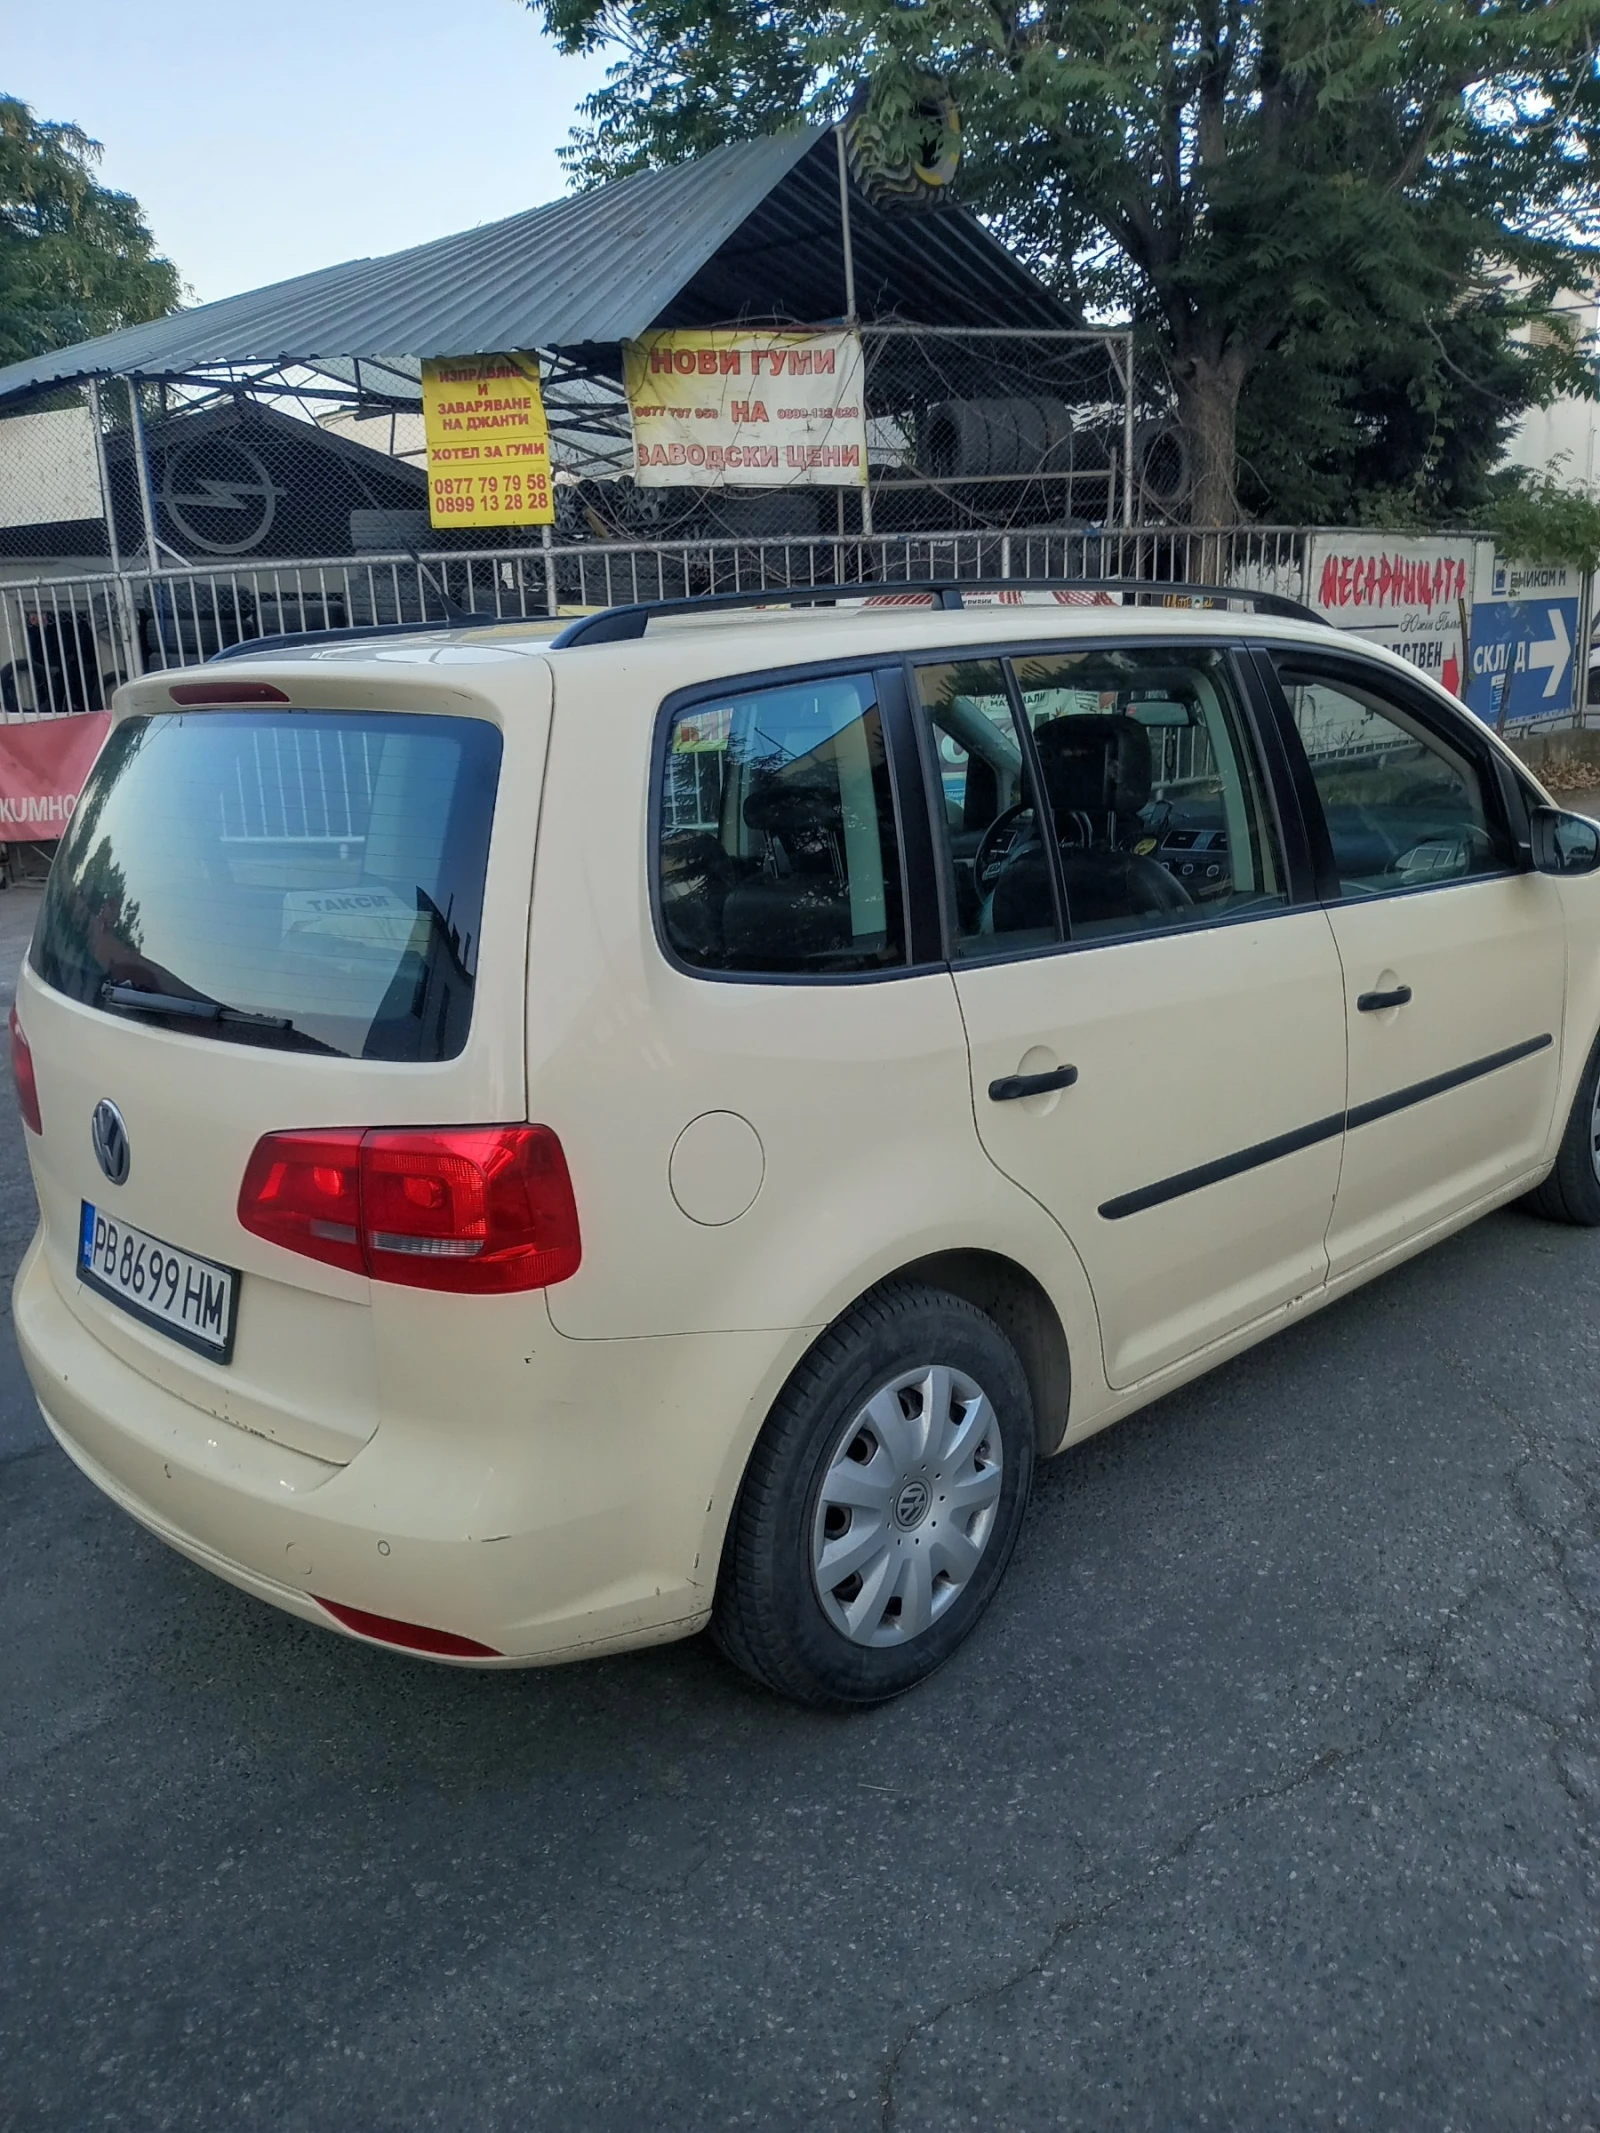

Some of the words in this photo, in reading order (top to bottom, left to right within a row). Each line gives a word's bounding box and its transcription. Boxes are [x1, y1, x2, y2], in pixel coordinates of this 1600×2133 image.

[650, 347, 740, 375] НОВИ
[751, 349, 835, 376] ГУМИ
[478, 383, 488, 396] И
[438, 397, 531, 414] ЗАВАРЯВАНЕ
[731, 400, 769, 422] НА
[443, 418, 463, 430] НА
[467, 414, 529, 431] ДЖАНТИ
[432, 447, 480, 460] ХОТЕЛ
[484, 445, 503, 458] ЗА
[506, 443, 545, 456] ГУМИ
[637, 443, 778, 471] ЗАВОДСКИ
[787, 445, 859, 471] ЦЕНИ
[434, 478, 473, 495] 0877
[478, 476, 498, 493] 79
[503, 474, 521, 492] 79
[527, 473, 547, 490] 58
[436, 496, 475, 513] 0899
[480, 495, 499, 511] 13
[504, 494, 523, 510] 28
[528, 492, 548, 509] 28
[0, 794, 77, 822] KUMHO
[307, 895, 390, 911] ТАКСИ
